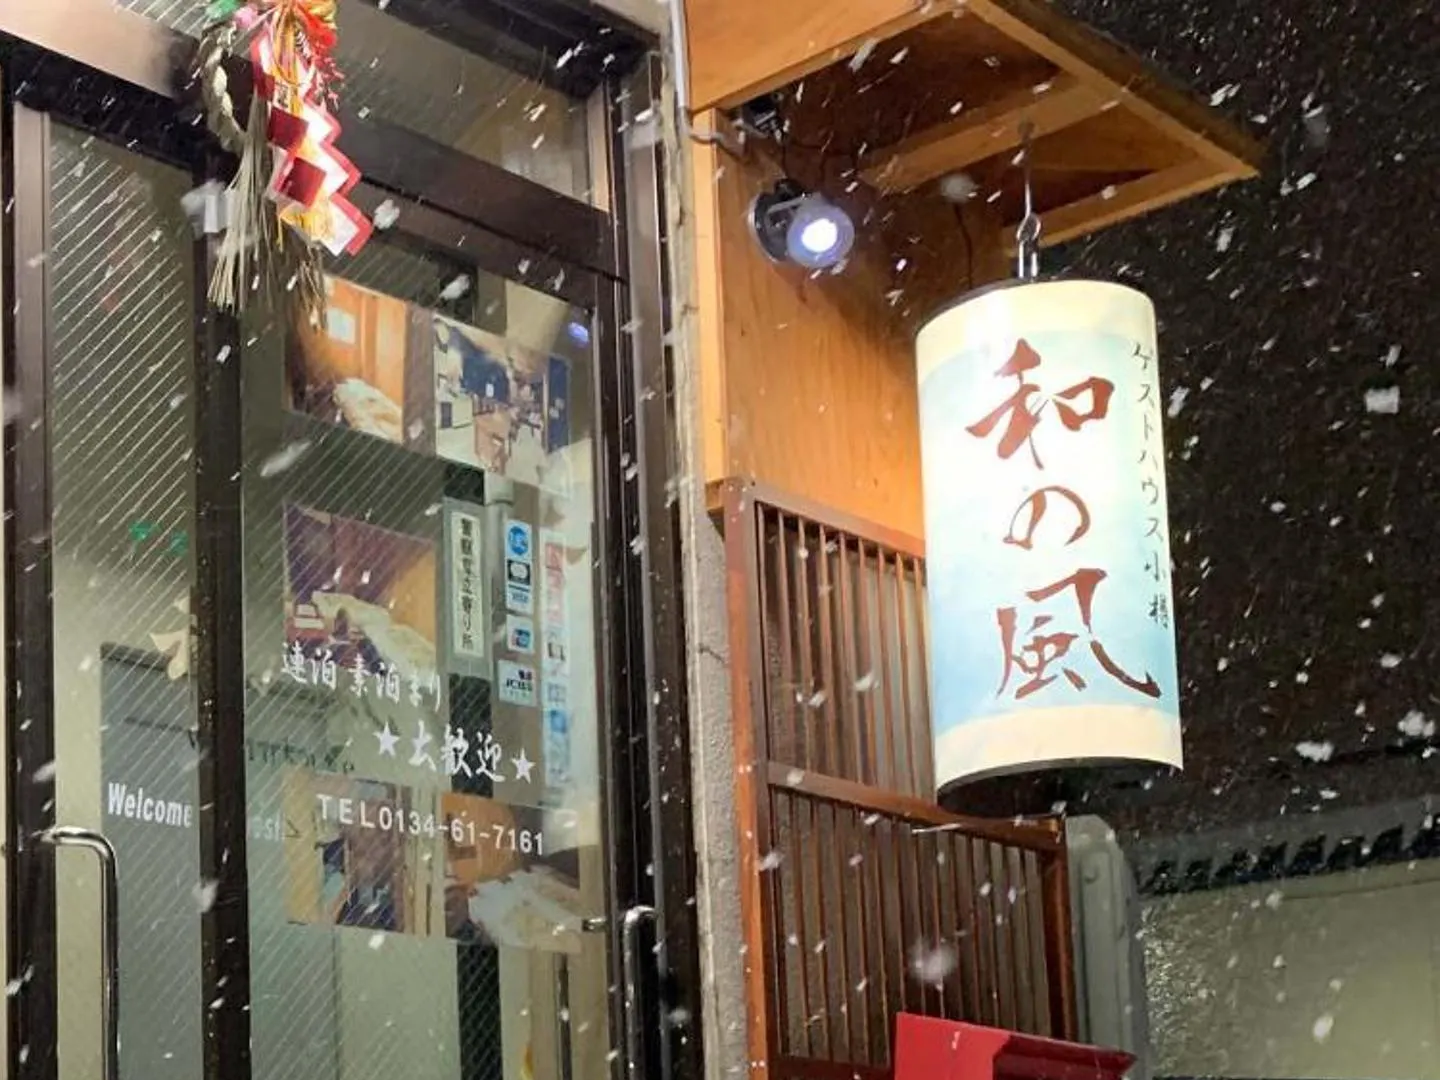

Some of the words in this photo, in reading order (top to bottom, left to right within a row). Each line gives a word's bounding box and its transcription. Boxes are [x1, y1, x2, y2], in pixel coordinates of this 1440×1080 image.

[965, 338, 1162, 699] 和の風
[108, 782, 193, 828] Welcome
